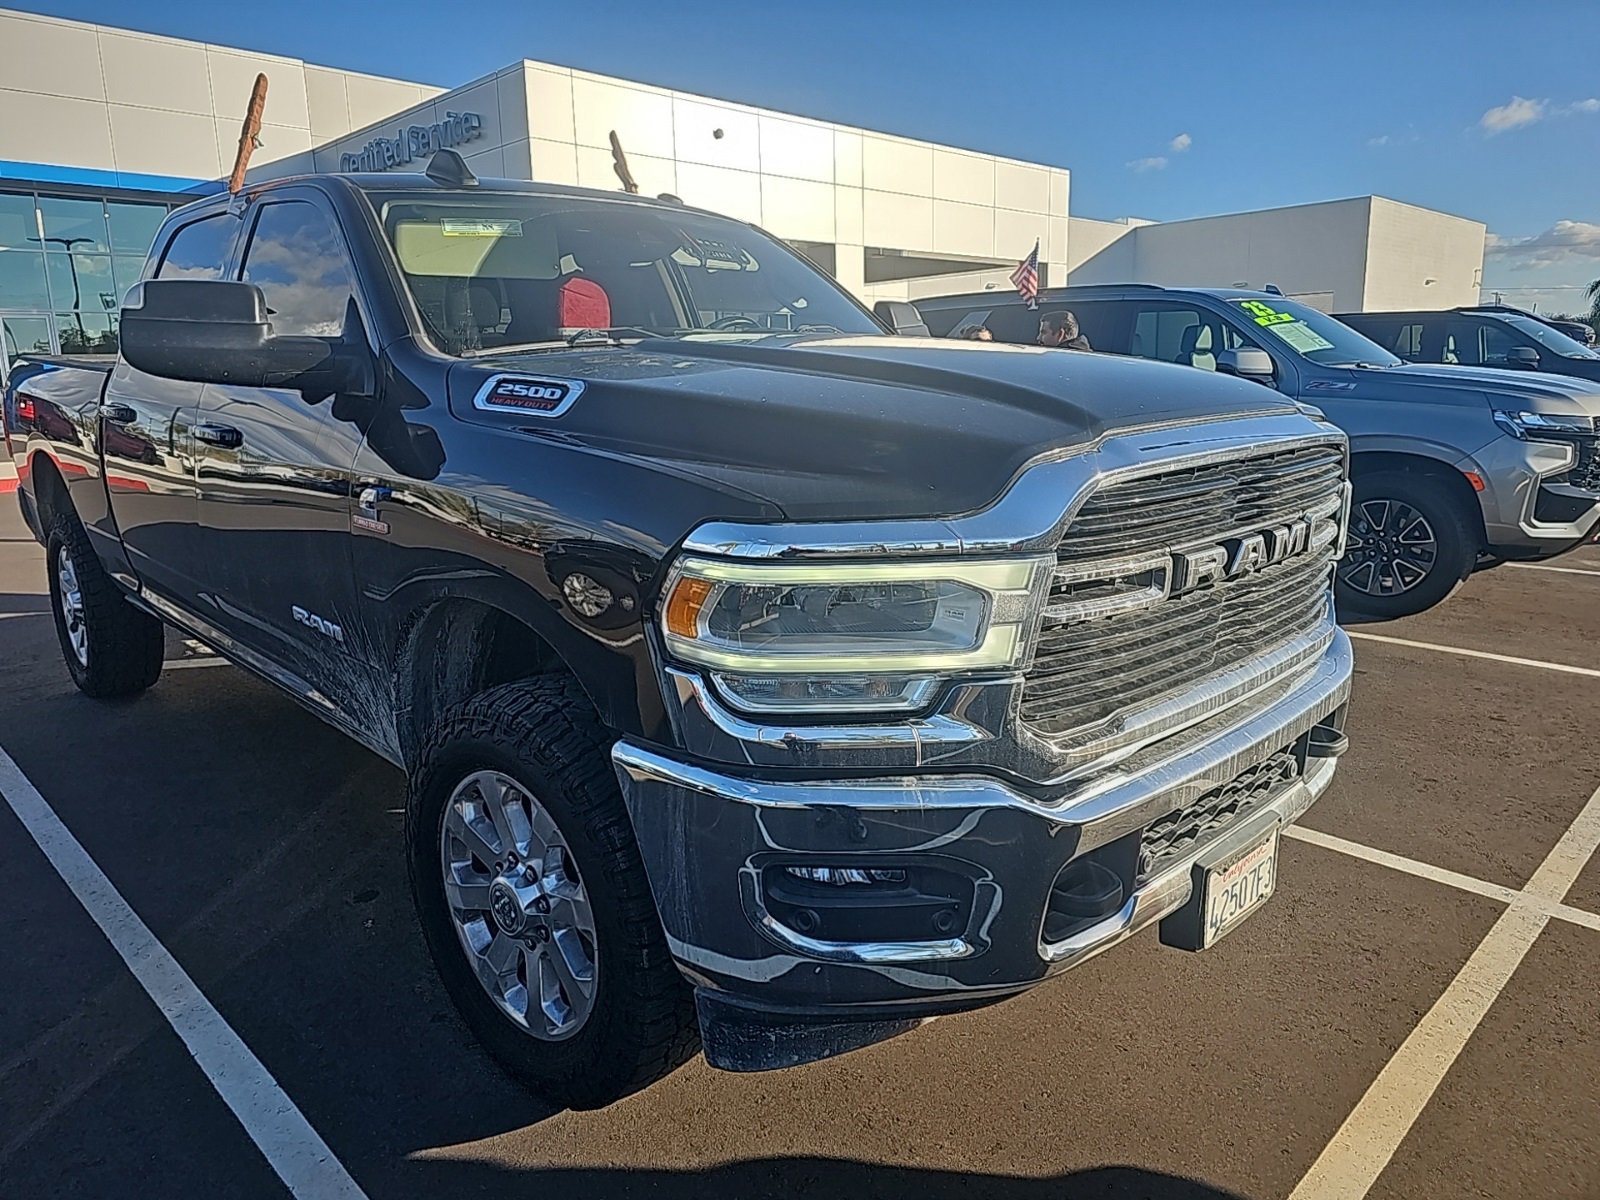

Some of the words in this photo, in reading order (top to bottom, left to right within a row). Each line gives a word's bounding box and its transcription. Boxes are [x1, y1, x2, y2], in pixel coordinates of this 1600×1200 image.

[340, 130, 411, 173] Certified
[407, 111, 481, 158] Service
[491, 397, 523, 406] HEAVY
[523, 400, 556, 410] DUTY
[496, 383, 562, 400] 2500
[1171, 518, 1308, 594] RAM
[292, 605, 343, 642] RAM
[1222, 844, 1268, 883] California
[1209, 855, 1273, 930] 42507F3
